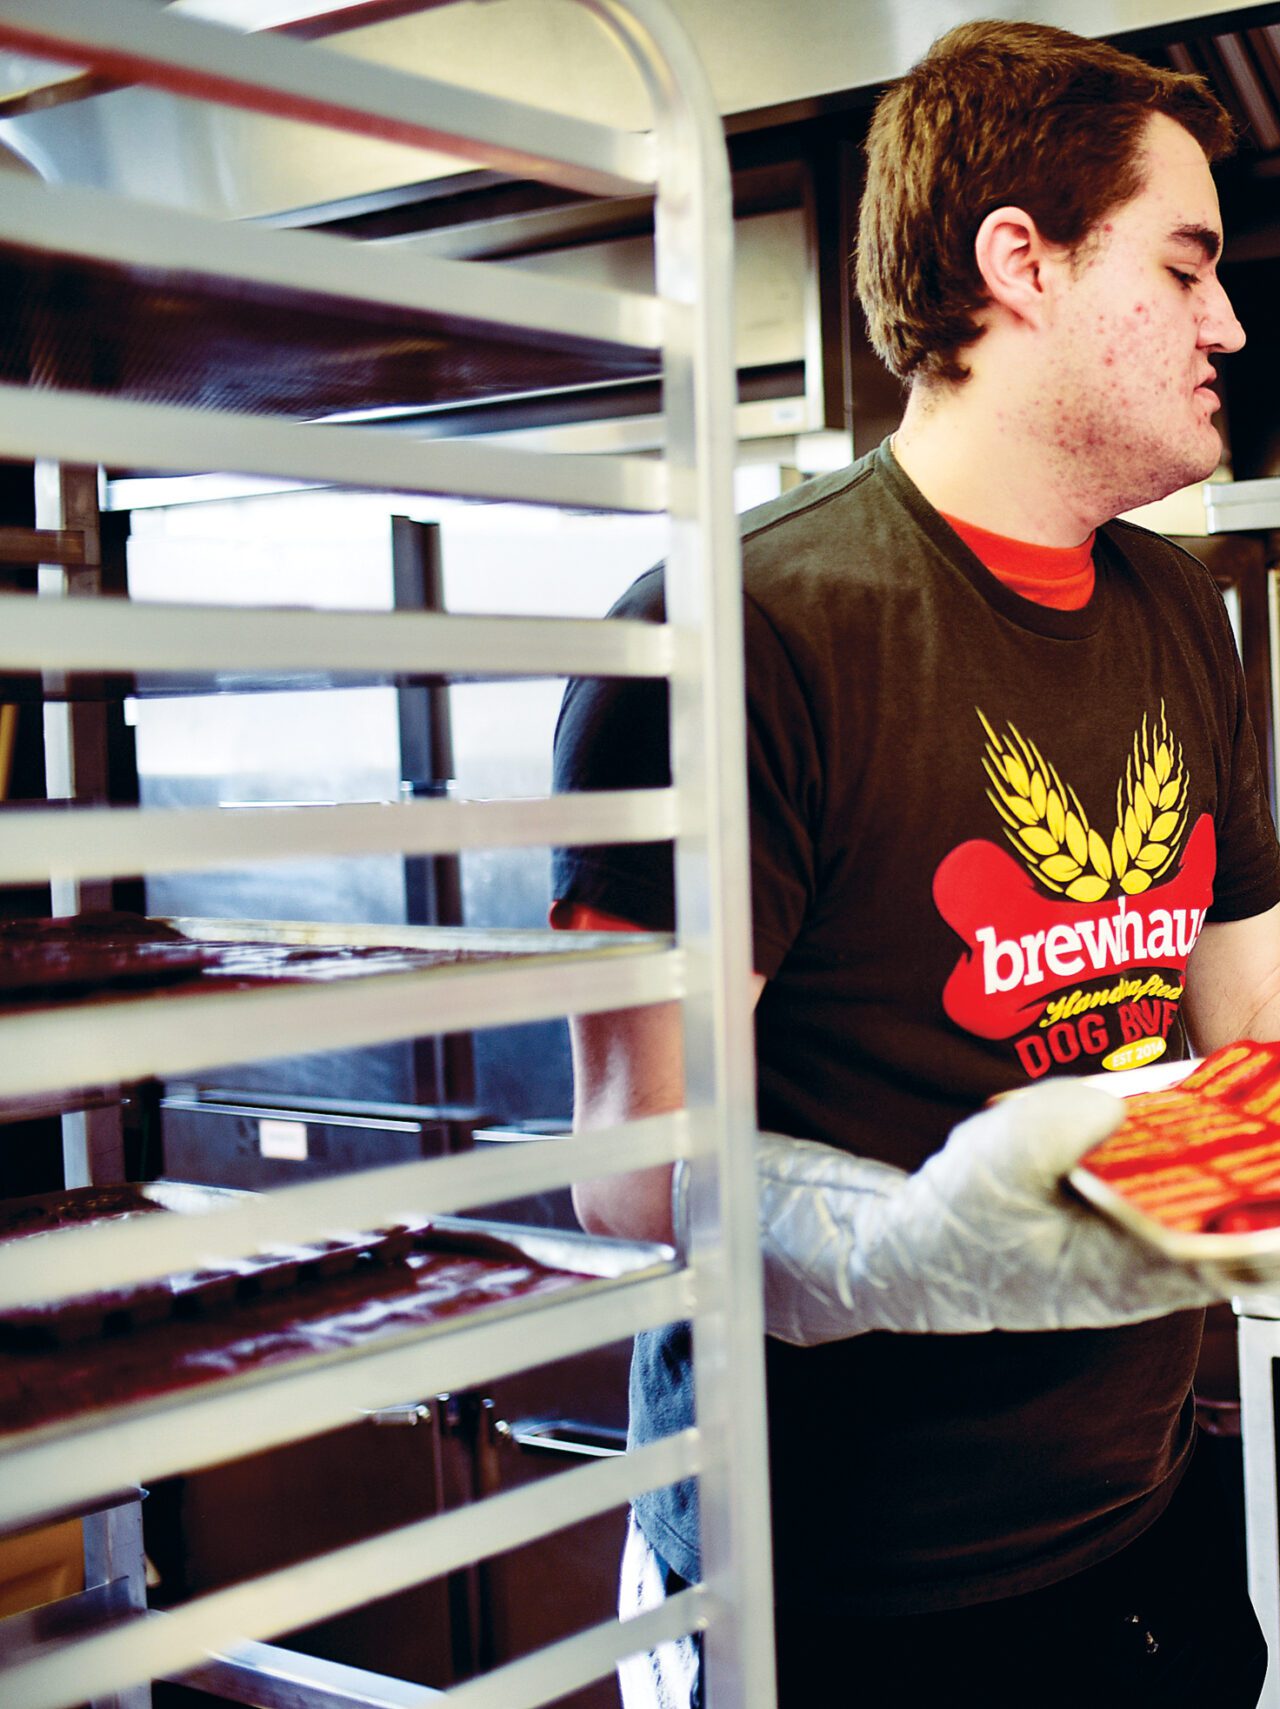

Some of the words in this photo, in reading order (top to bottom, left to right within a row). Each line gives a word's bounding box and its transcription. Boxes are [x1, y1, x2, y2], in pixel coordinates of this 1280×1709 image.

[975, 895, 1207, 995] brewhau
[1014, 1013, 1110, 1079] DOG
[1112, 1050, 1133, 1068] EST
[1136, 1040, 1164, 1061] 2014
